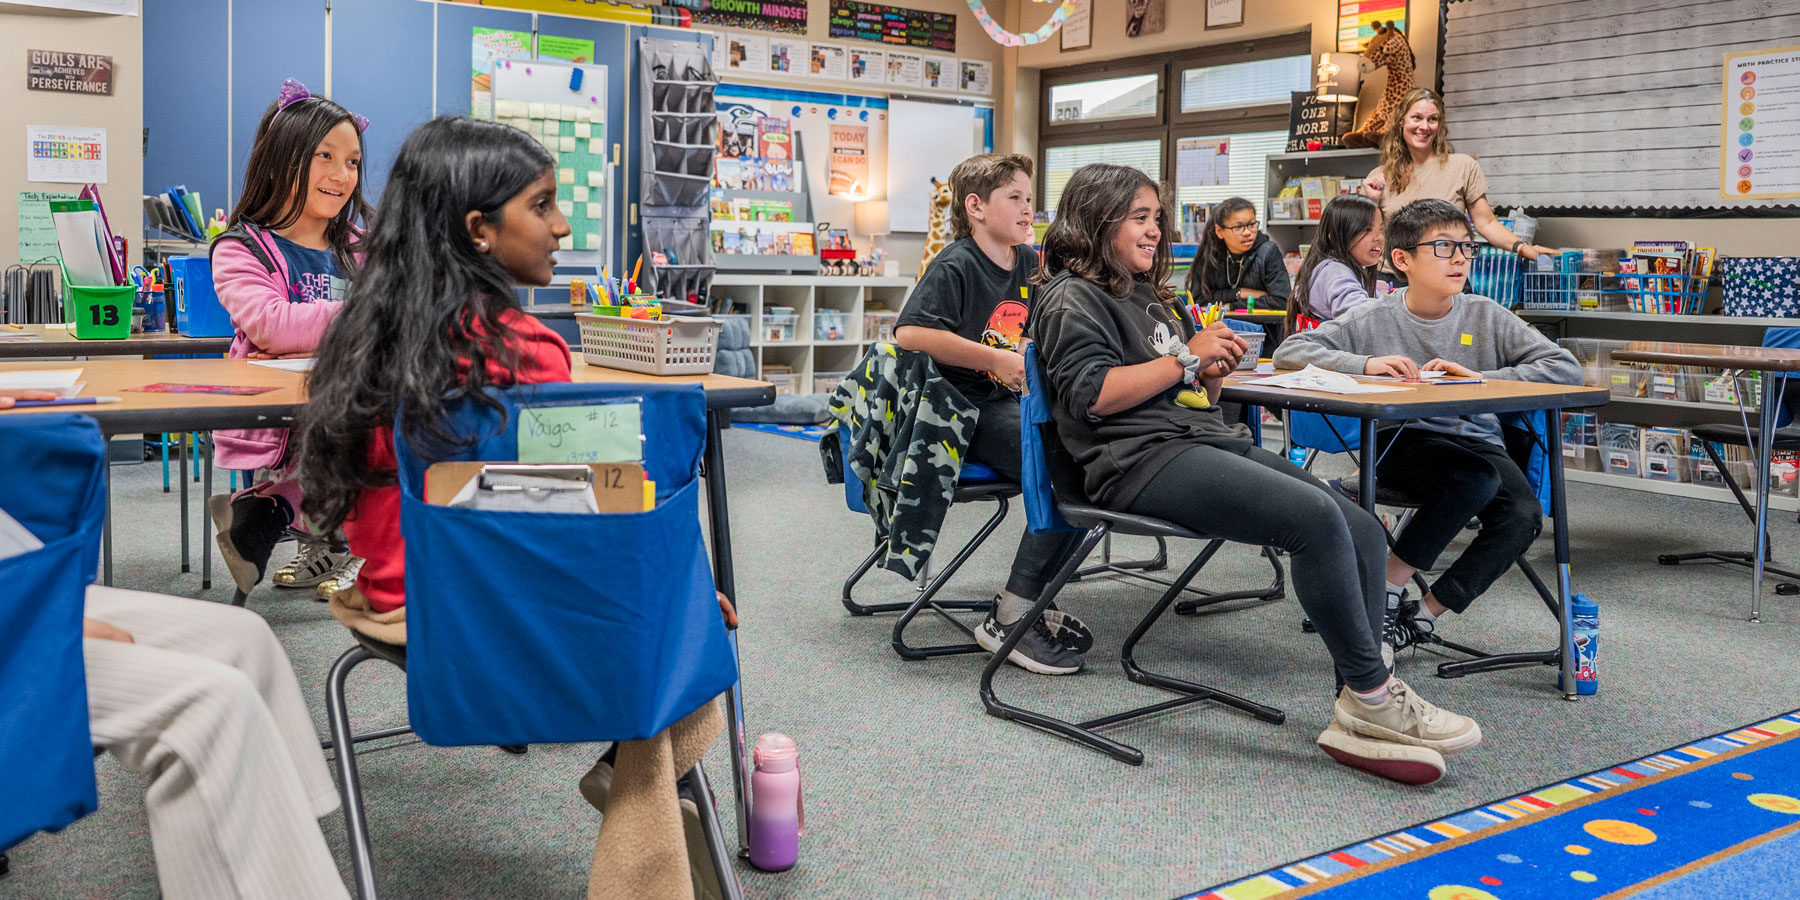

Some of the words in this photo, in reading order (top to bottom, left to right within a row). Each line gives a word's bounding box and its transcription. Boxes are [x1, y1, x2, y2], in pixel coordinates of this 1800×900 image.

[712, 0, 760, 14] GROWTH
[762, 3, 807, 20] MINDSET
[32, 51, 75, 67] GOALS
[79, 55, 104, 69] ARE
[1758, 58, 1789, 66] PRACTICE
[54, 67, 85, 75] ACHIEVED
[32, 77, 107, 93] PERSEVERANCE
[1301, 107, 1327, 119] ONE
[1296, 121, 1329, 135] MORE
[833, 132, 865, 142] TODAY
[21, 192, 39, 201] Tech
[302, 272, 330, 287] THE
[90, 304, 119, 326] 13
[604, 467, 624, 489] 12
